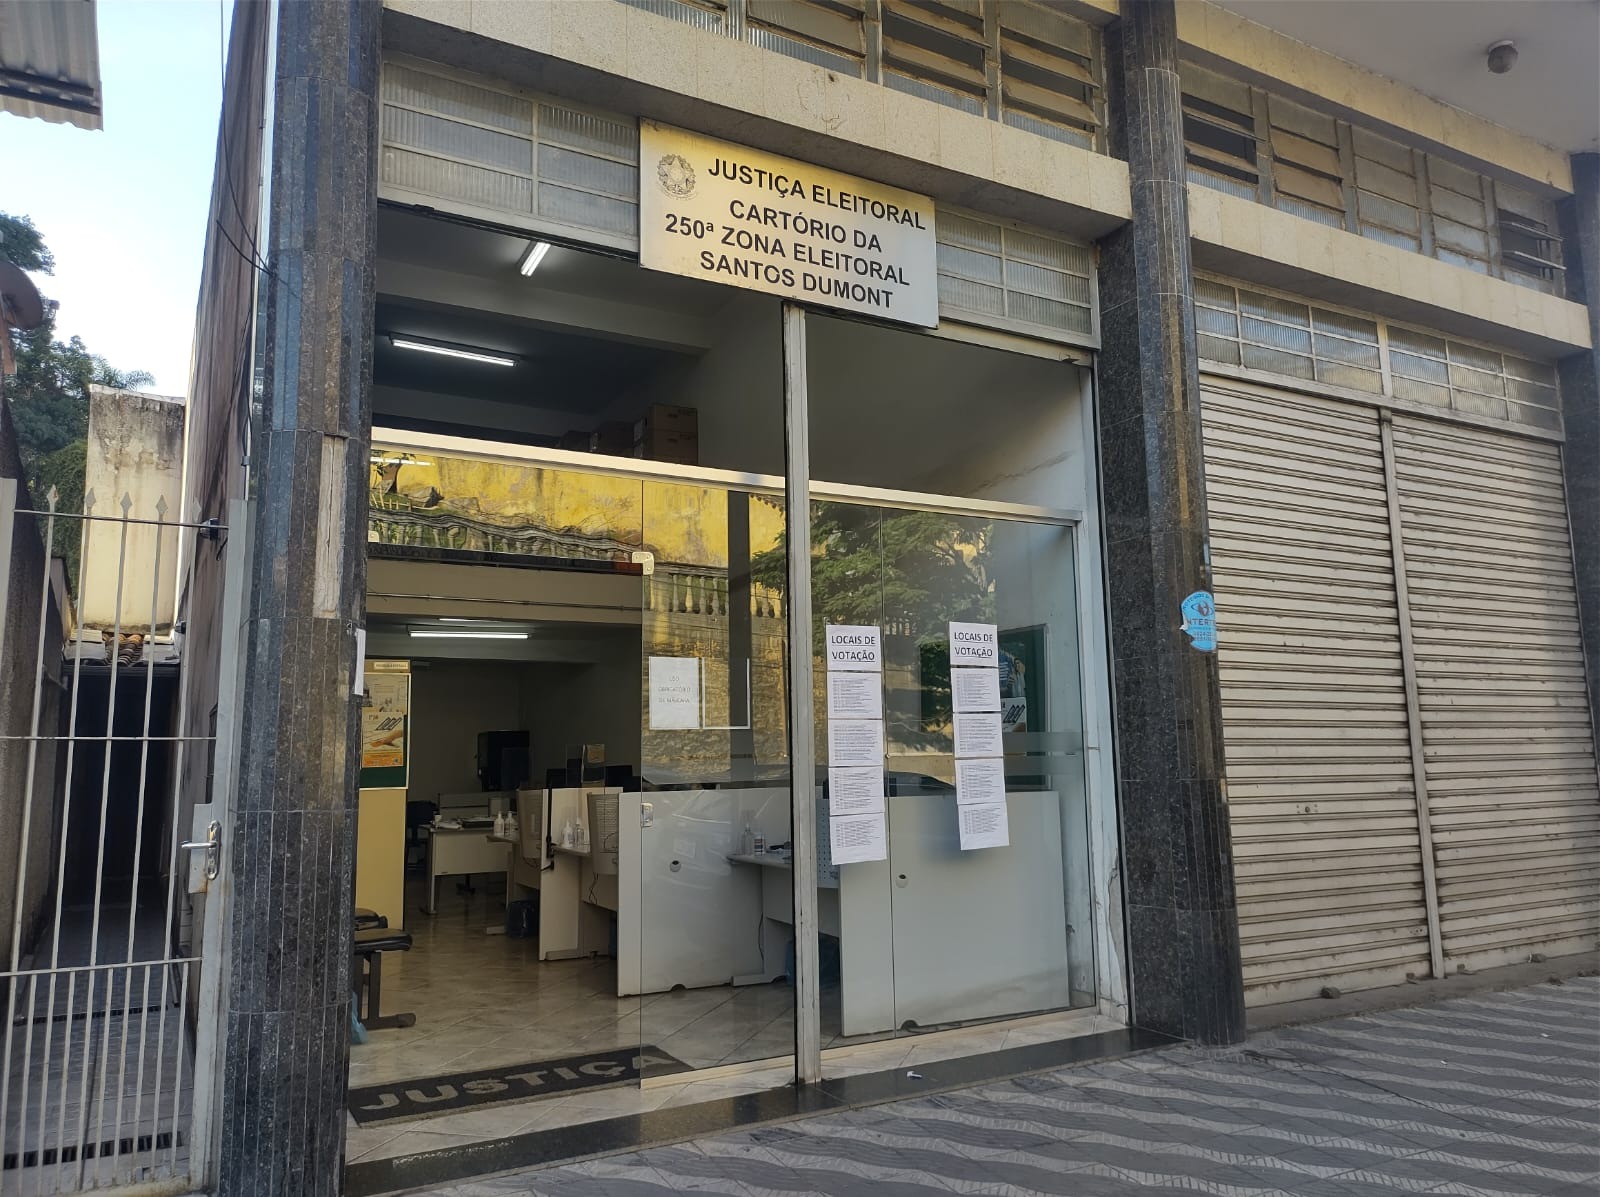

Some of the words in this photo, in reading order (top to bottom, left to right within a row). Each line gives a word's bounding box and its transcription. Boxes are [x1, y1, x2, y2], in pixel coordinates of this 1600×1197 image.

[708, 158, 806, 199] JUSTIÇA
[812, 184, 927, 231] ELEITORAL
[665, 213, 714, 240] 250ª
[721, 225, 786, 258] ZONA
[794, 242, 910, 286] ELEITORAL
[729, 199, 847, 244] CARTÓRIO
[853, 229, 882, 253] DA
[700, 250, 796, 288] SANTOS
[803, 272, 894, 309] DUMONT
[831, 635, 862, 645] LOCAIS
[864, 636, 876, 645] DE
[831, 649, 876, 661] VOTAÇÃO
[954, 631, 981, 642] LOCAIS
[983, 633, 993, 642] DE
[954, 646, 993, 658] VOTAÇÃO
[359, 1055, 679, 1111] JUSTIÇA
